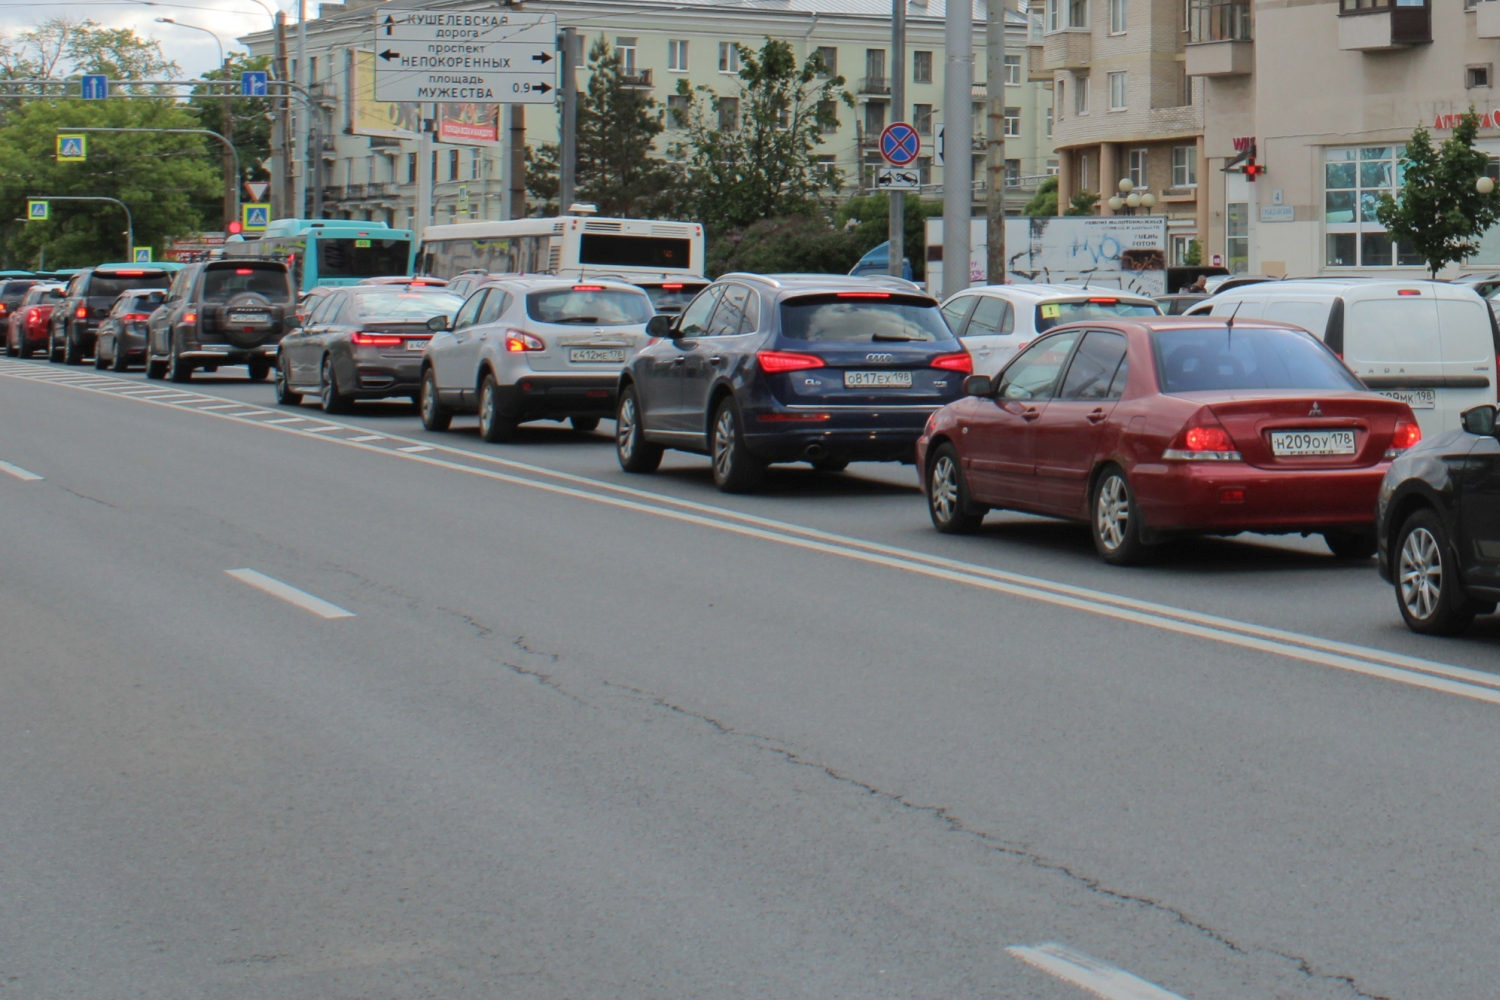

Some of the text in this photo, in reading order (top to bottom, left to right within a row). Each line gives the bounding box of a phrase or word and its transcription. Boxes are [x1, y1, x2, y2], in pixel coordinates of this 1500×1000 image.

[407, 14, 509, 27] КУШЕЛЕВСКАЯ
[436, 28, 480, 39] дорога
[428, 43, 485, 56] проспект
[401, 56, 511, 69] НЕПОКОРЕННЫХ
[428, 74, 485, 86] площадь
[417, 87, 494, 99] МУЖЕСТВА
[512, 82, 531, 94] 0.9
[1416, 391, 1433, 401] 198
[1276, 433, 1350, 450] Н209ОУ 178
